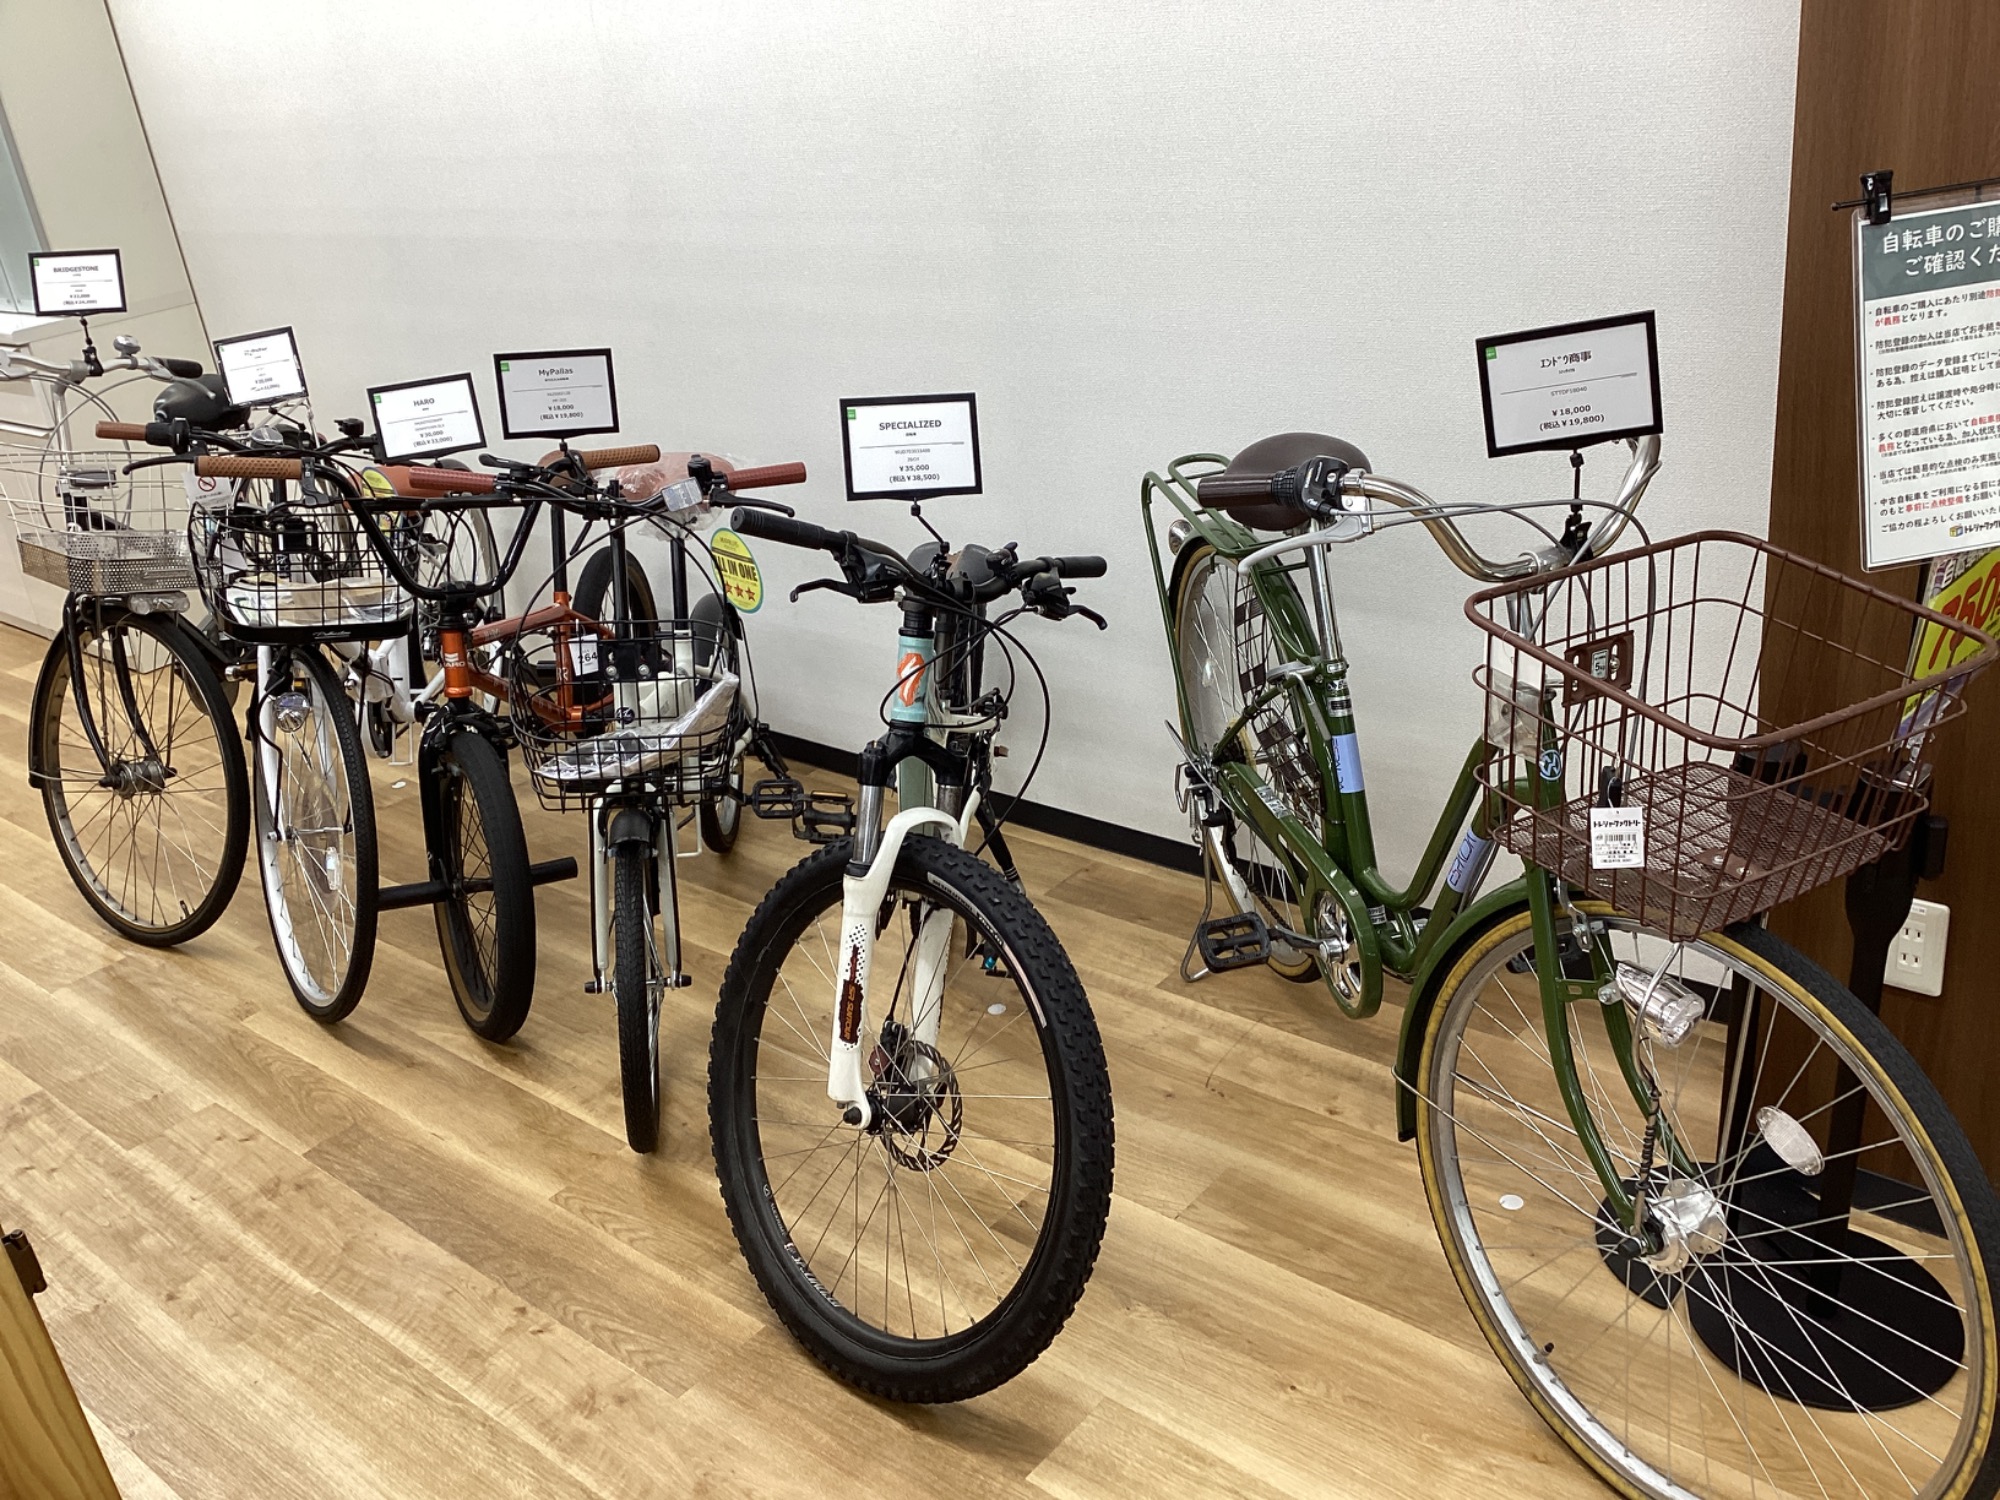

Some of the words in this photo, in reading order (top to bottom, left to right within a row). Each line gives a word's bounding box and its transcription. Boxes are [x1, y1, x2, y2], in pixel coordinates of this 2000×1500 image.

[538, 367, 574, 377] MyPallas
[413, 397, 435, 407] HARO
[1552, 404, 1592, 417] ¥18,000
[879, 419, 942, 431] SPECIALIZED
[899, 464, 930, 472] ¥35,000
[738, 563, 758, 582] ONE
